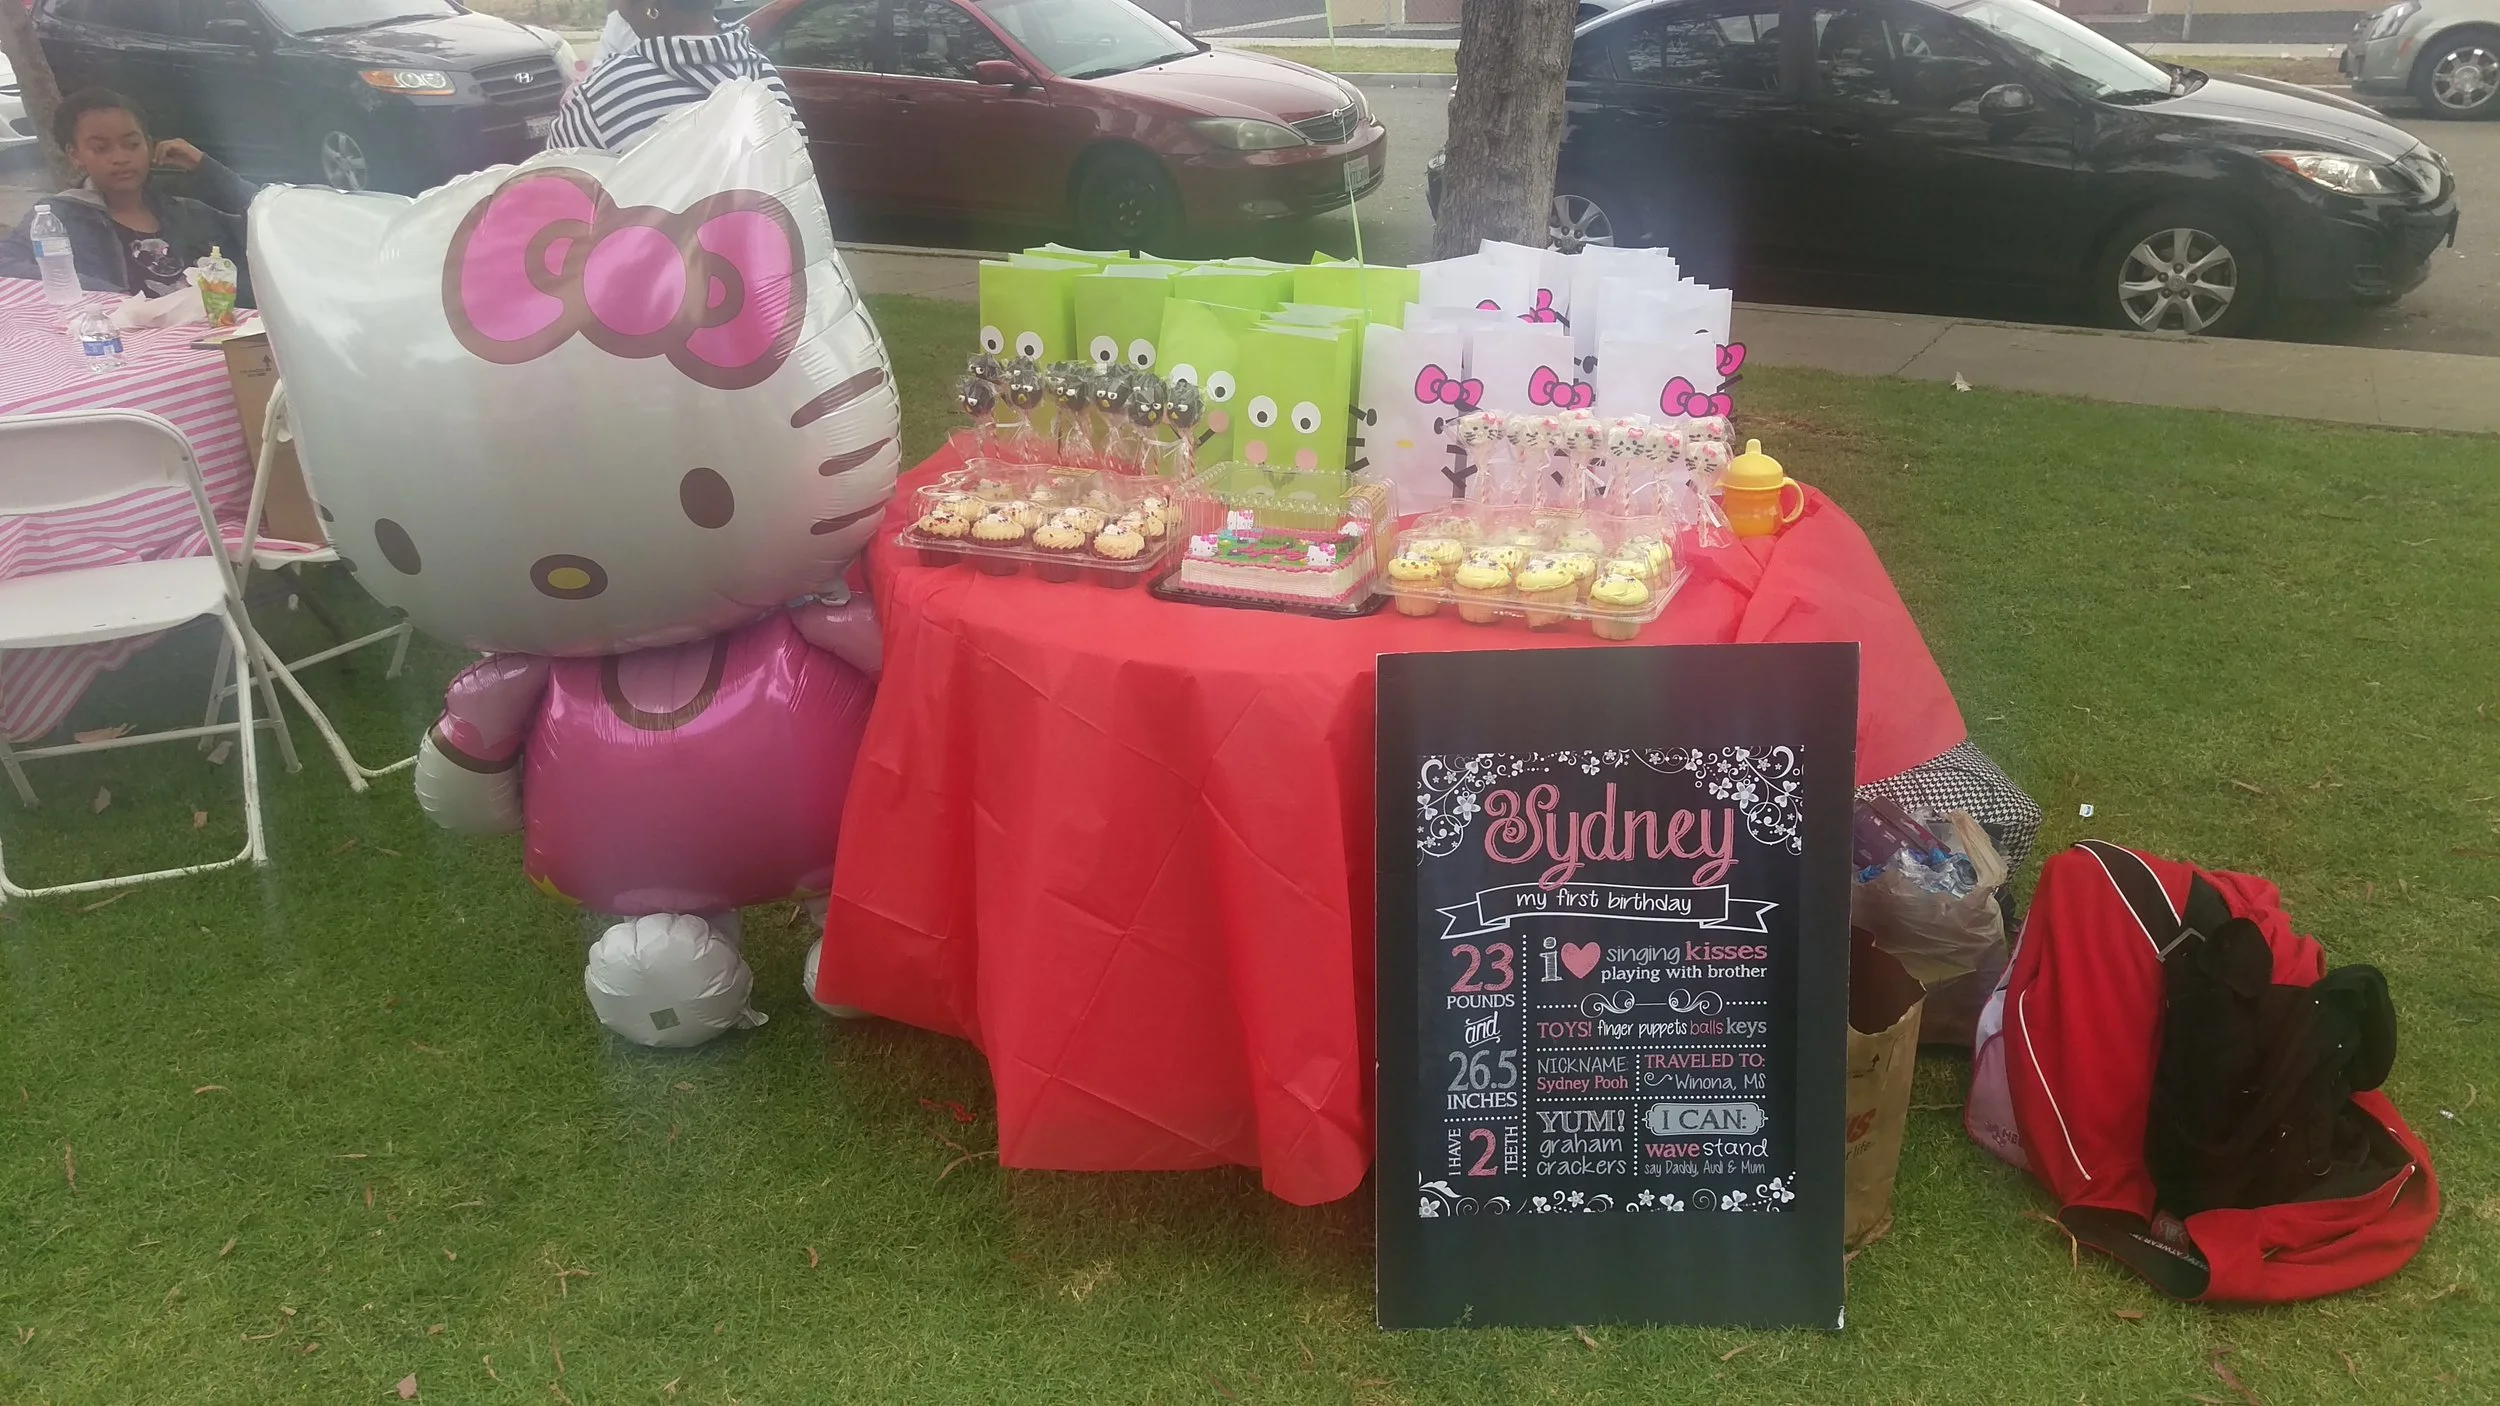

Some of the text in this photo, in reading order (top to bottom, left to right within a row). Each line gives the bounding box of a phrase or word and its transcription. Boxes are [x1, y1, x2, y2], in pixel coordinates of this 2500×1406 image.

[1484, 782, 1739, 891] Sydney
[1516, 887, 1692, 915] my first birthday
[1539, 936, 1563, 982] i
[1605, 941, 1768, 965] singing kisses
[1451, 942, 1515, 992] 23
[1600, 964, 1768, 984] playing with brother
[1446, 993, 1516, 1009] POUNDS
[1464, 1010, 1501, 1045] and
[1537, 1017, 1767, 1039] TOYS! finger puppets balls keys
[1447, 1049, 1518, 1091] 26.5
[1645, 1053, 1766, 1069] TRAVELED TO:
[1536, 1075, 1629, 1093] Sydney Pooh
[1674, 1072, 1767, 1092] Winona, MS
[1446, 1091, 1518, 1110] INCHES
[1535, 1109, 1626, 1134] YUM!
[1661, 1109, 1748, 1130] I CAN:
[1448, 1128, 1462, 1168] HAVE
[1467, 1128, 1498, 1176] 2
[1504, 1126, 1519, 1174] TEETH
[1539, 1133, 1623, 1158] graham
[1644, 1137, 1769, 1158] wave stand
[1536, 1155, 1628, 1176] crackers
[1644, 1163, 1662, 1177] say
[1727, 1159, 1737, 1175] &
[1741, 1159, 1766, 1175] Mum
